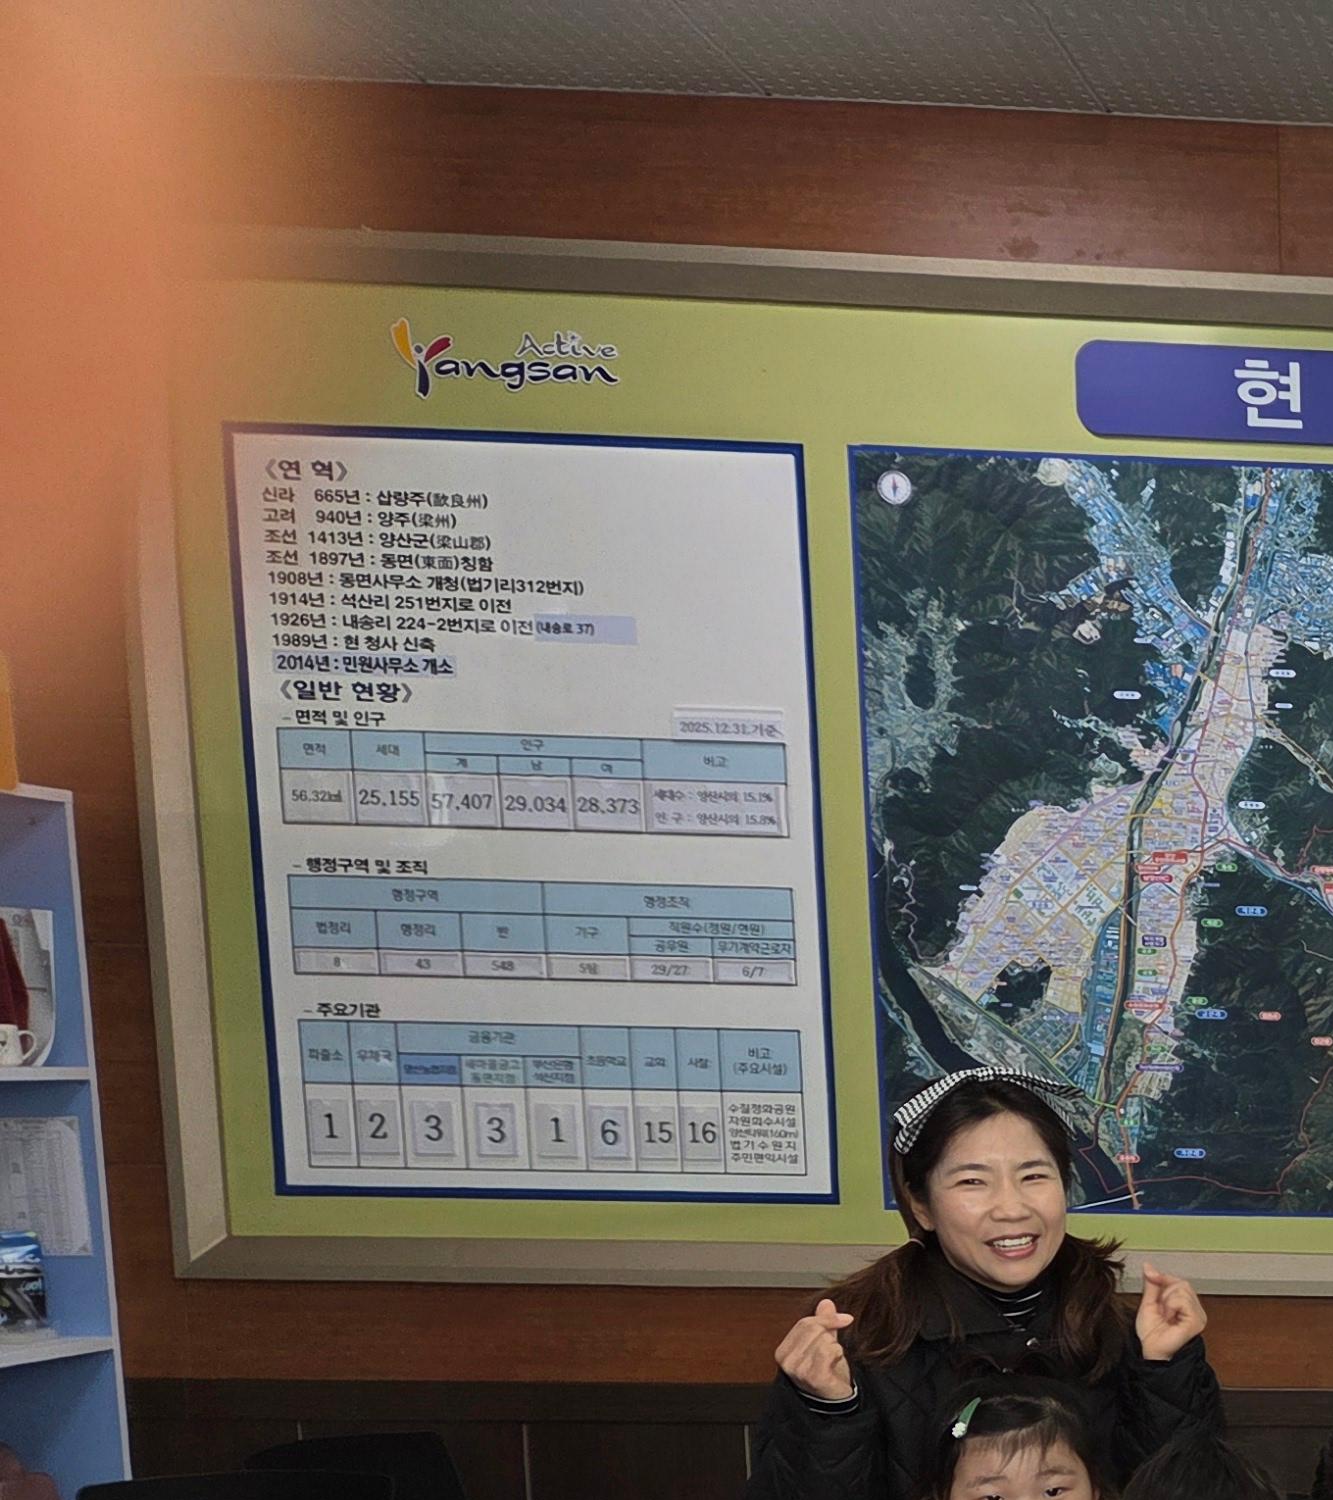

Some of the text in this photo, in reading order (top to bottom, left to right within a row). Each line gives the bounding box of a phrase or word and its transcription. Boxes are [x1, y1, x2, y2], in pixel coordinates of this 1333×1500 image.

[517, 330, 617, 358] Active
[261, 486, 296, 503] 신라
[314, 488, 361, 506] 665년
[262, 507, 296, 525] 고려
[315, 509, 362, 527] 940년
[263, 528, 298, 546] 조선
[307, 530, 364, 548] 1413년
[264, 549, 299, 566] 조선
[308, 551, 365, 569] 1897년
[268, 570, 584, 597] 1908년 동면사무소 개청(법기리312번지)
[269, 591, 513, 615] 1914년 석산리 251번지로 이전
[270, 612, 327, 630] 1926년
[342, 614, 392, 632] 내송리
[396, 616, 497, 635] 224-2번지로
[499, 618, 534, 637] 이전
[272, 633, 437, 653] 1989년 현 청사 신축
[276, 654, 455, 676] 2014년 민원사무소 개소
[295, 708, 387, 728] 면적 및 인구
[302, 741, 327, 757] 면적
[305, 857, 429, 875] 행정구역 및 조직
[316, 1002, 382, 1019] 주요기관
[747, 1046, 774, 1060] 비고
[322, 1112, 718, 1146] 1 2 3 3 1 6 15 16
